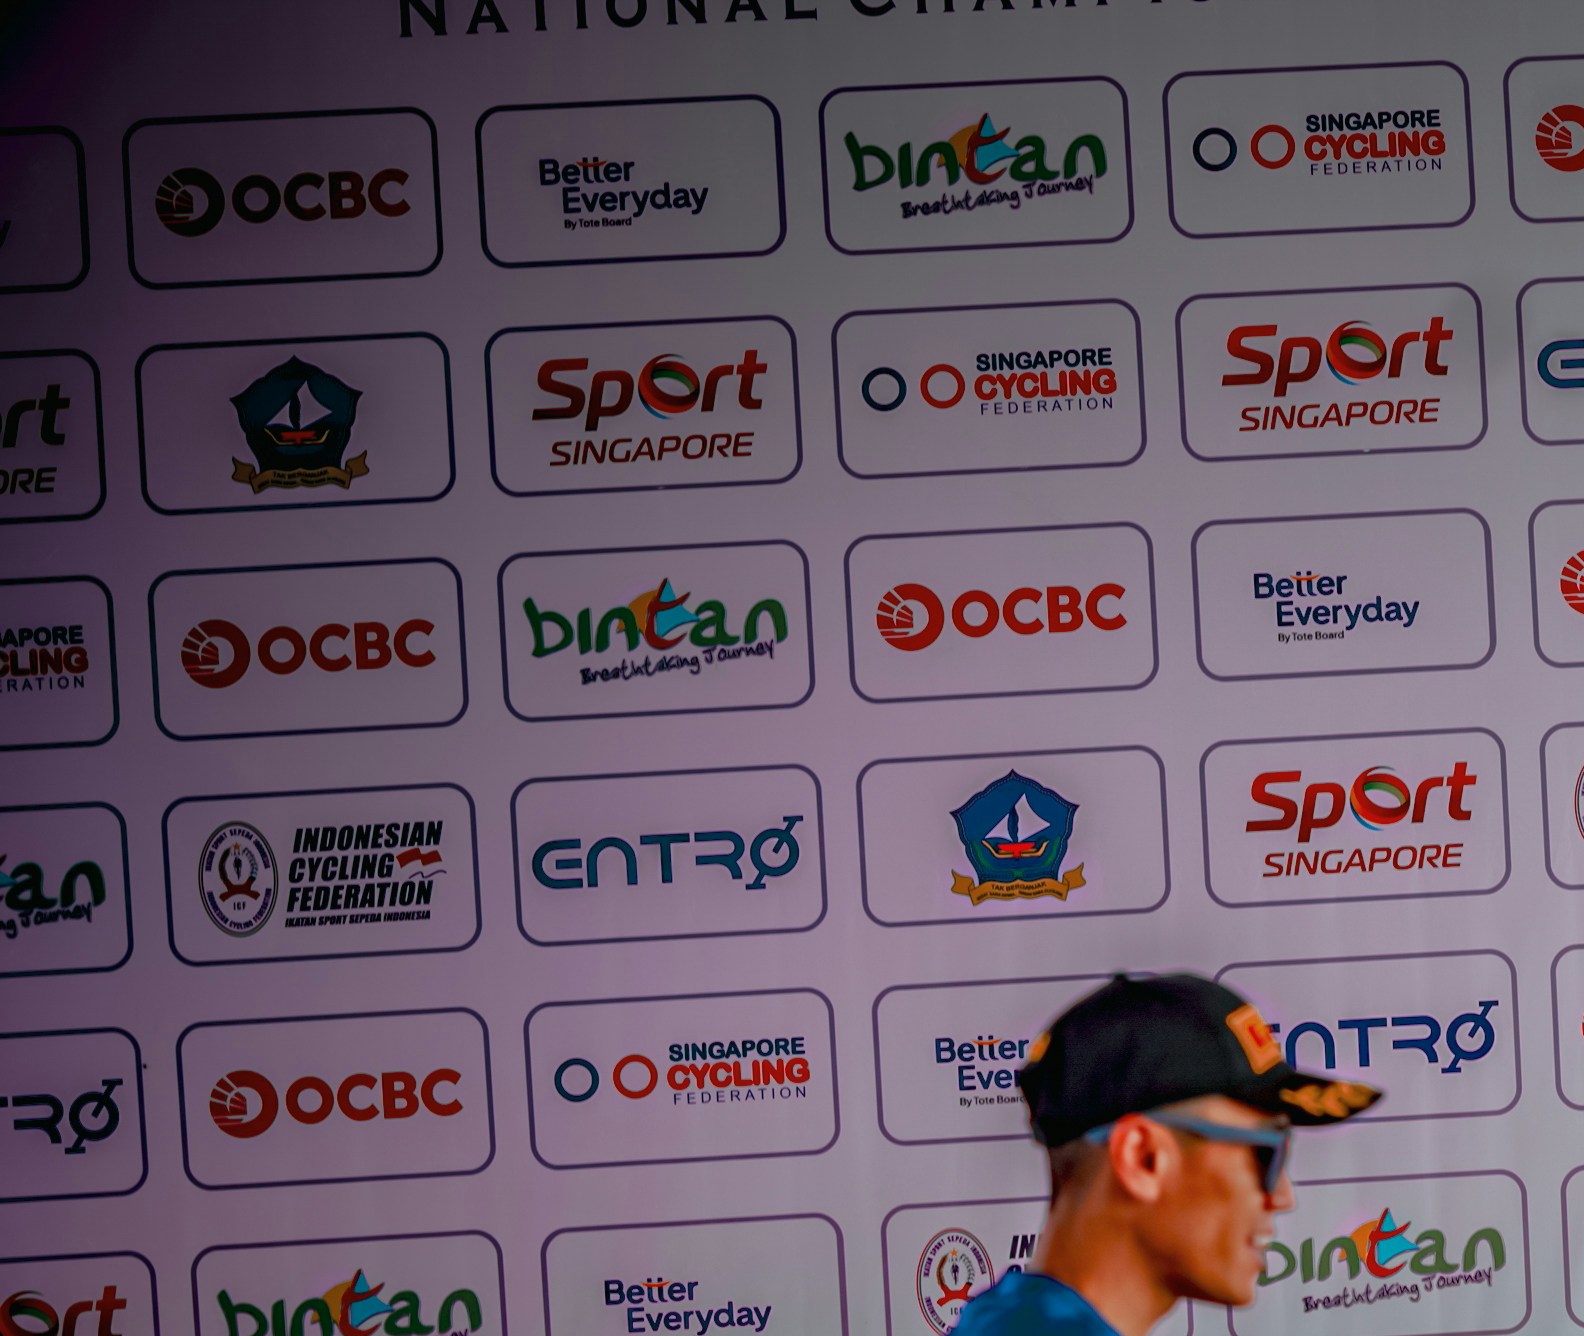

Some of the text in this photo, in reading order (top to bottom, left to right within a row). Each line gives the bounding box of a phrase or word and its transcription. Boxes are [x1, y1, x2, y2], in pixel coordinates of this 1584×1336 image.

[1306, 109, 1441, 132] SINGAPORE
[844, 112, 1107, 191] bintan
[1304, 130, 1445, 161] CYCLING
[538, 157, 634, 185] Better
[1310, 158, 1441, 175] FEDERATION
[231, 168, 410, 223] OCBC
[562, 182, 708, 222] Everyday
[900, 175, 1094, 218] Breathtaking Journey
[976, 347, 1112, 372] SINGAPORE
[1221, 317, 1453, 397] Sport
[532, 349, 767, 431] Sport
[974, 368, 1117, 400] CYCLING
[980, 397, 1112, 415] FEDERATION
[1239, 398, 1440, 431] SINGAPORE
[549, 432, 754, 466] SINGAPORE
[1253, 571, 1347, 598] Better
[523, 578, 788, 657] bintan
[951, 583, 1127, 638] OCBC
[1276, 595, 1419, 630] Everyday
[0, 627, 83, 647] APORE
[257, 619, 435, 675] OCBC
[1278, 630, 1344, 643] By Tote Board
[579, 640, 774, 684] Breathtaking Journey
[1245, 762, 1476, 843] Sport
[292, 820, 443, 853] INDONESIAN
[288, 853, 394, 883] CYCLING
[1263, 843, 1463, 877] SINGAPORE
[286, 880, 433, 912] FEDERATION
[284, 910, 430, 927] IKATAN SPORT SEPEDA INDONESIA
[669, 1037, 805, 1062] SINGAPORE
[935, 1035, 1029, 1063] Better
[1268, 1000, 1498, 1074] NTRO
[667, 1057, 810, 1090] CYCLING
[285, 1068, 462, 1124] OCBC
[673, 1086, 806, 1105] FEDERATION
[974, 1096, 995, 1106] Tote
[604, 1277, 698, 1305] Better
[1303, 1266, 1493, 1312] Breathtaking Journey
[627, 1301, 771, 1336] Everyday
